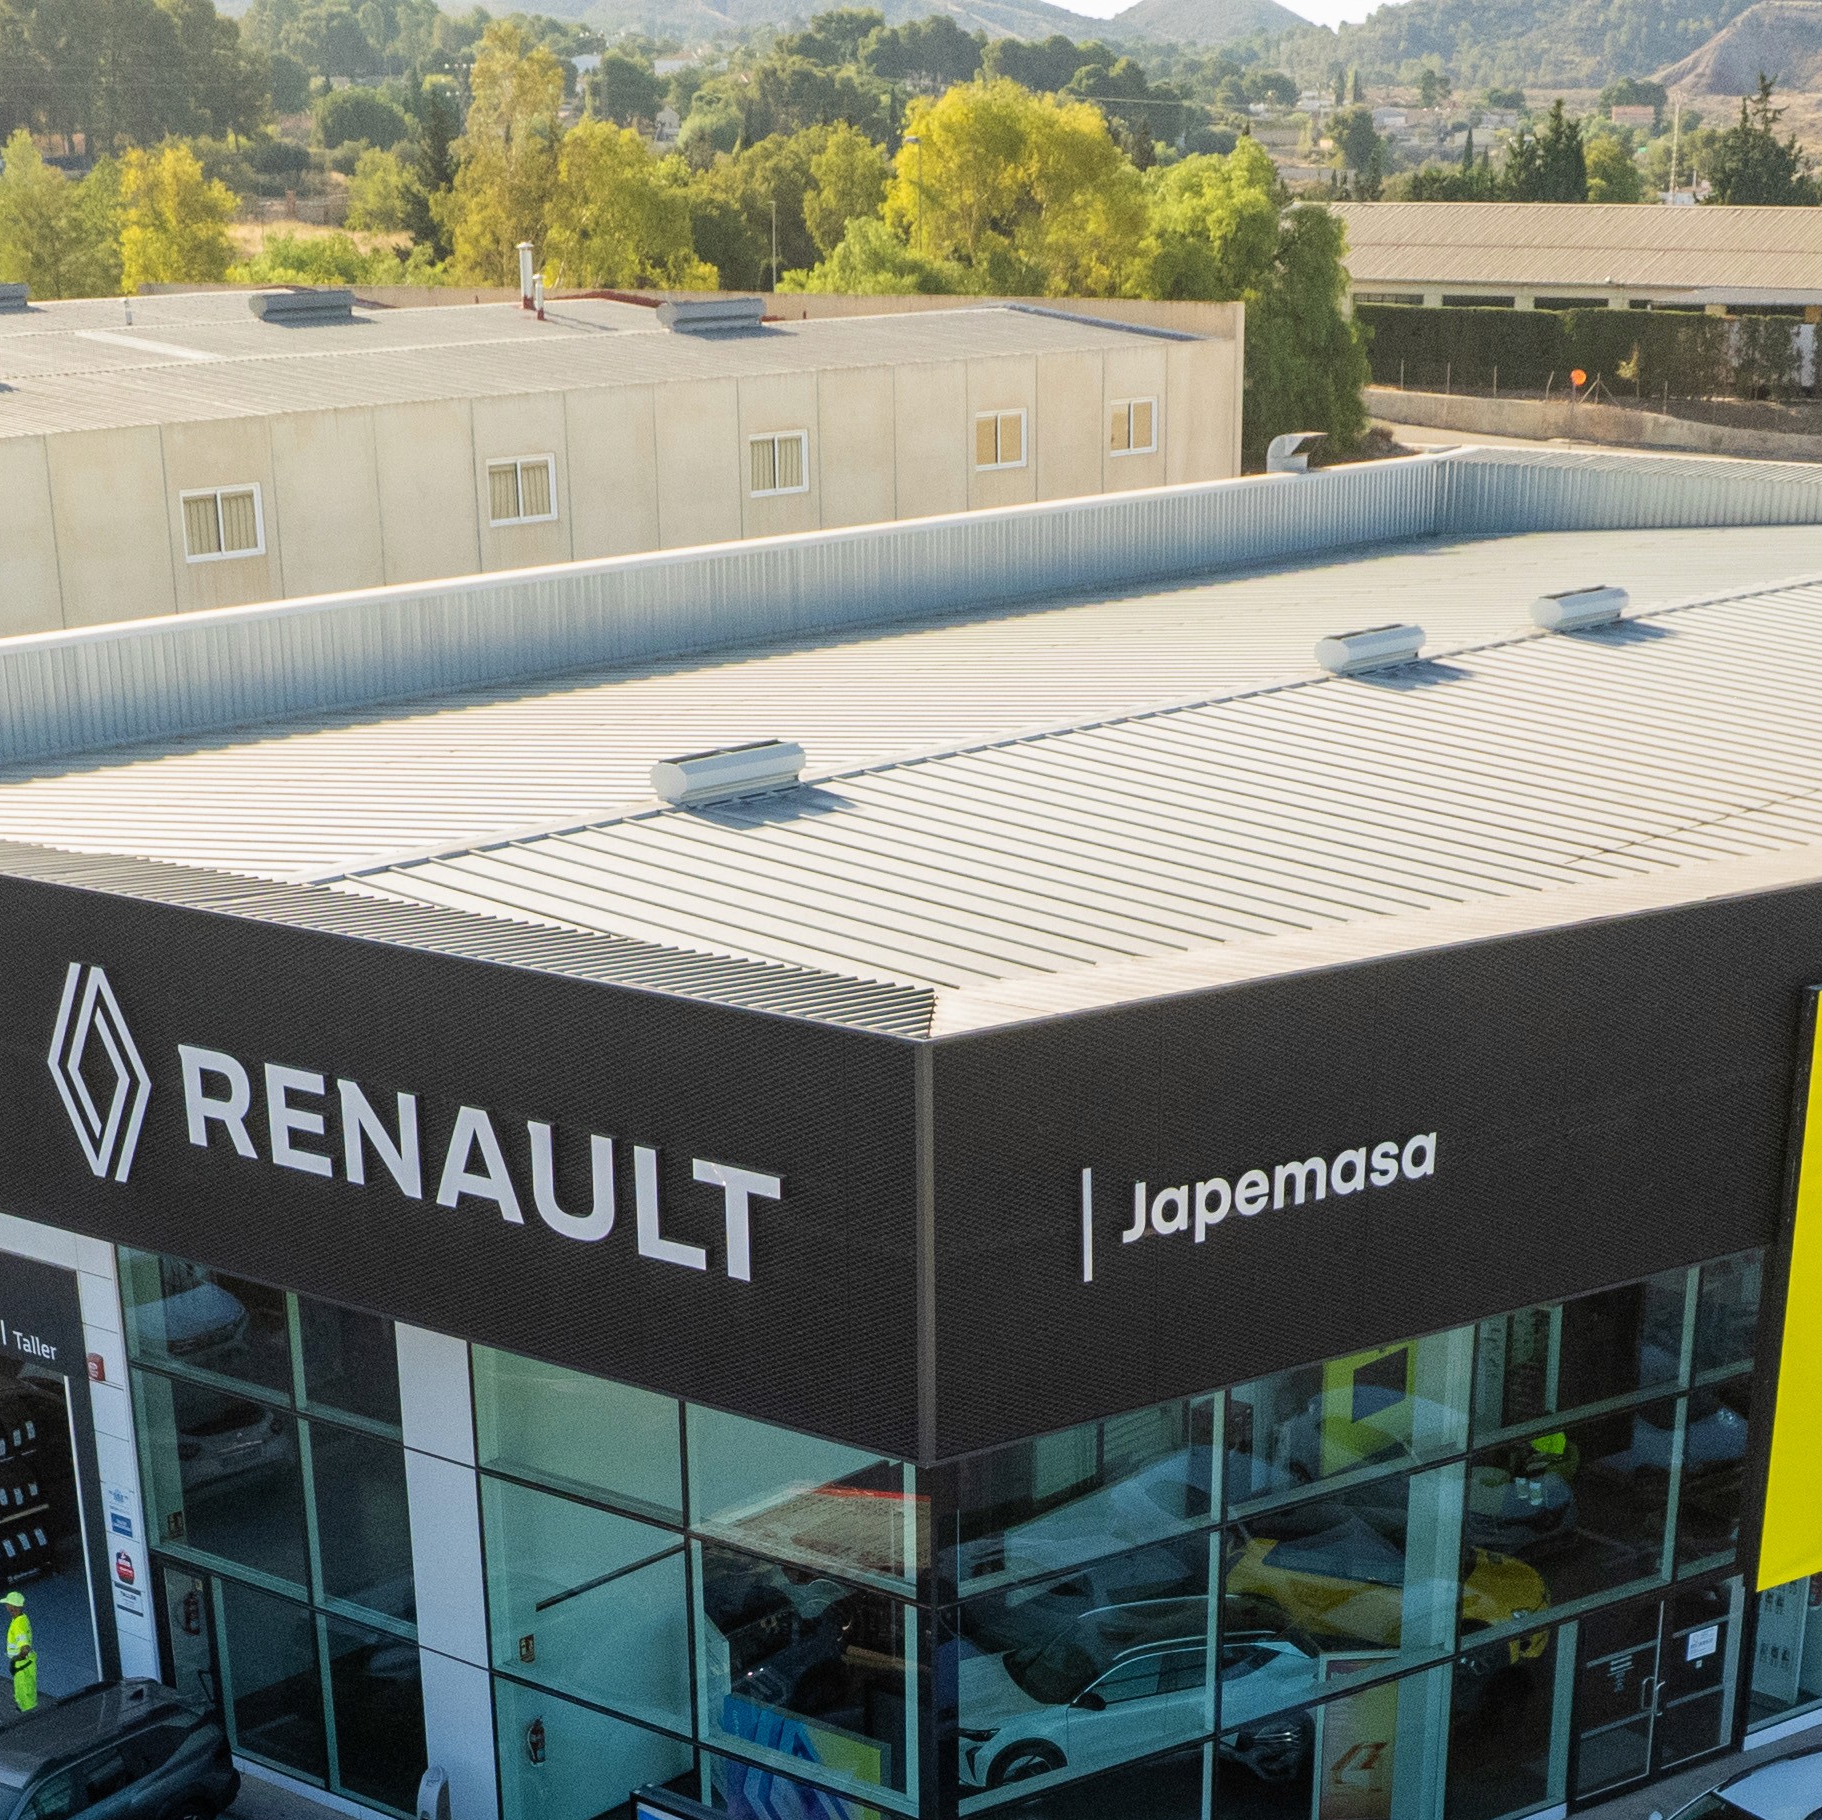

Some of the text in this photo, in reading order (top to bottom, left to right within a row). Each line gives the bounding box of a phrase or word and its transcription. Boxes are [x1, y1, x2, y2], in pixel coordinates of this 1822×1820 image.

[178, 1045, 782, 1281] RENAULT
[1123, 1132, 1437, 1243] Japemasa
[13, 1331, 56, 1360] Taller
